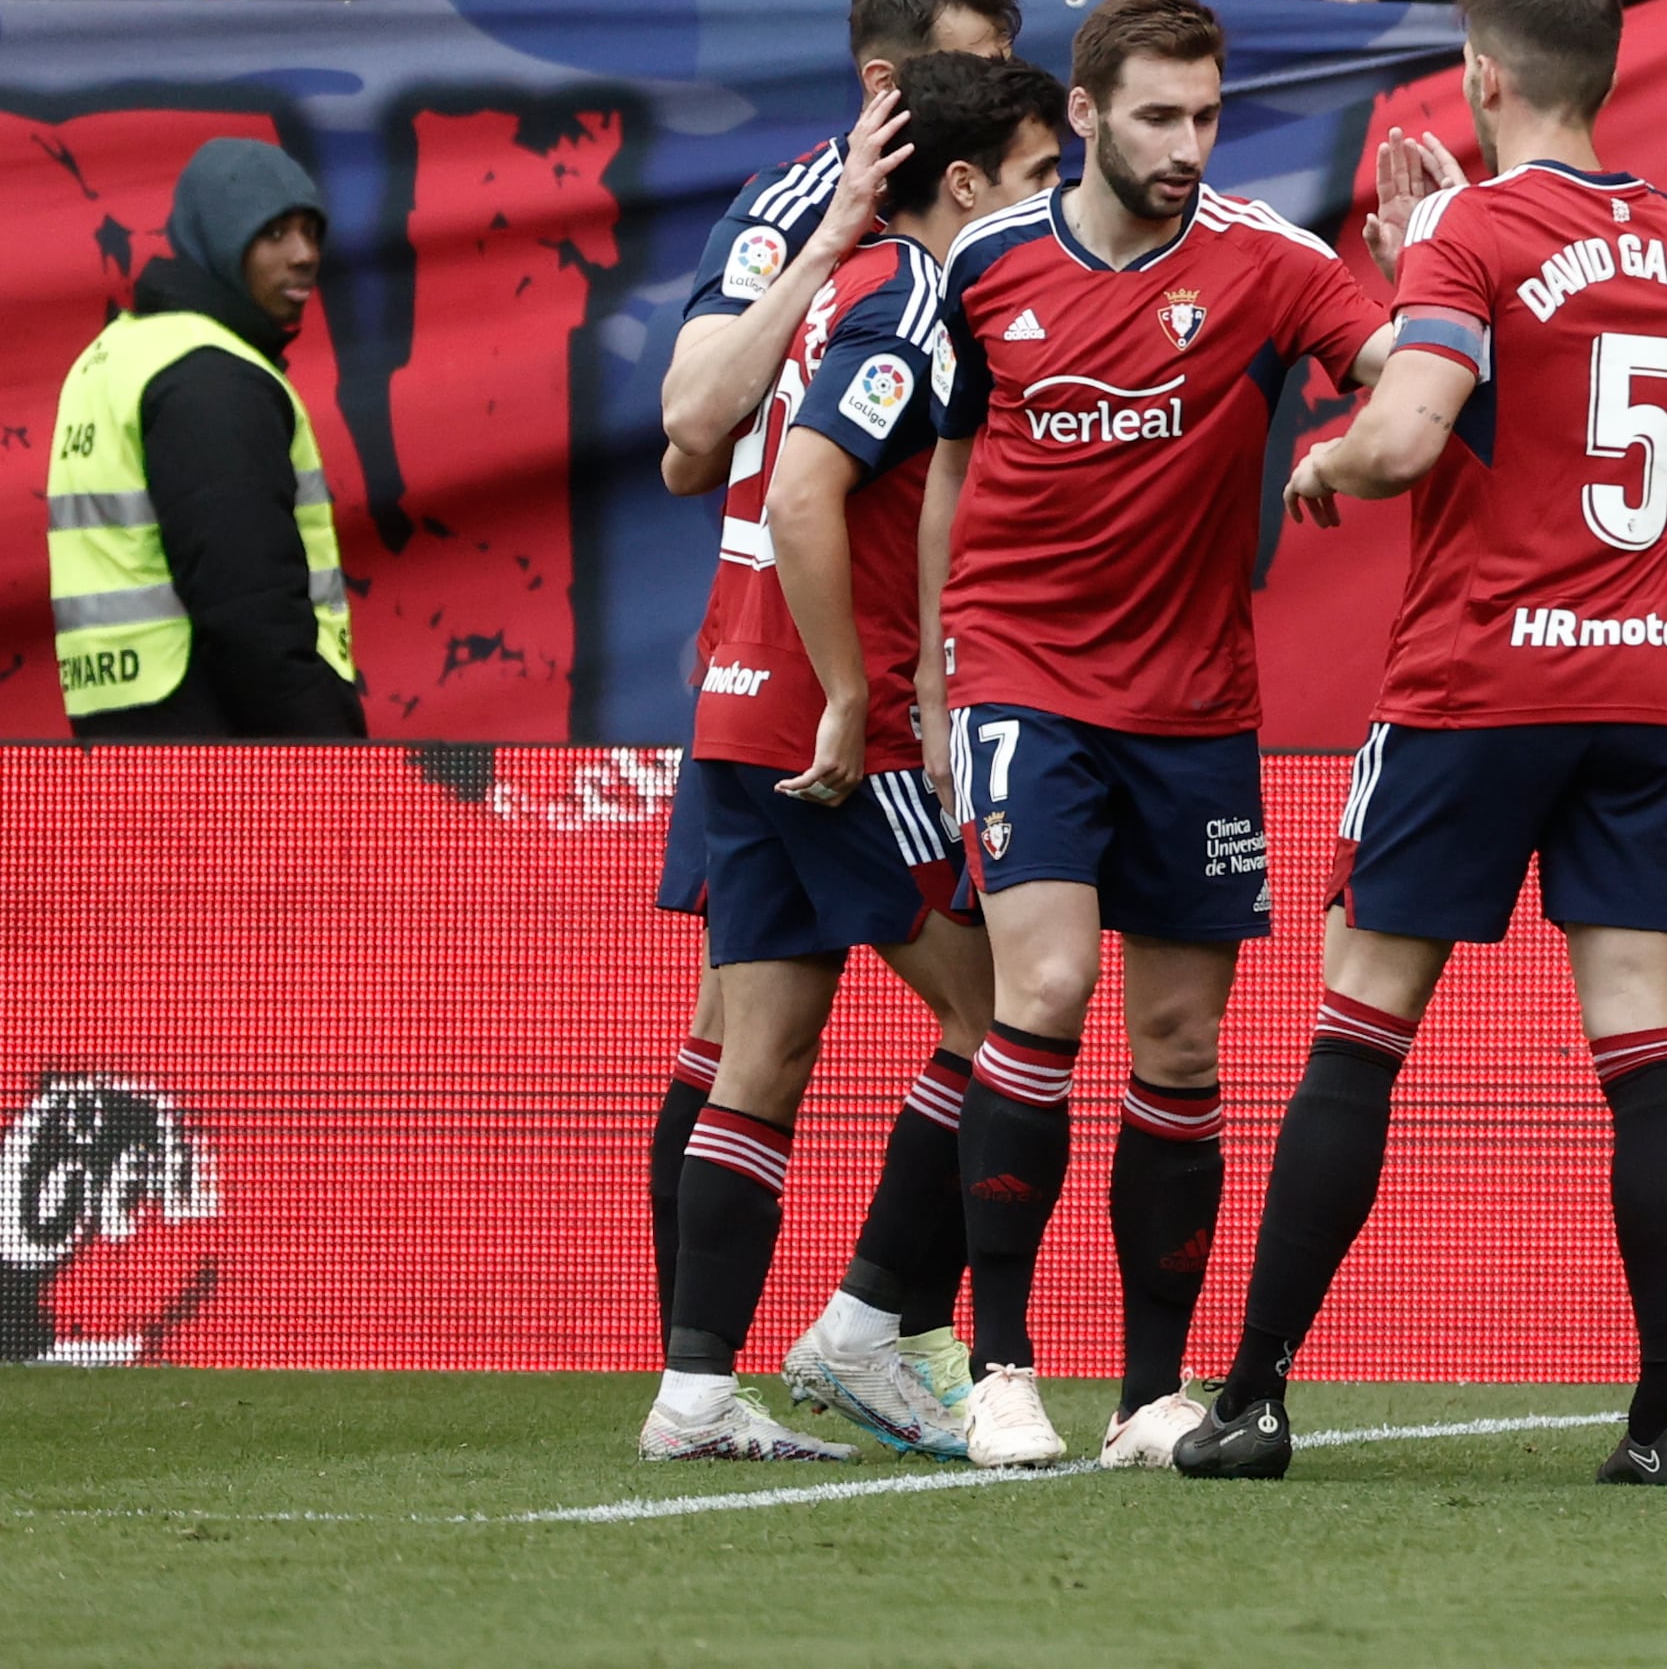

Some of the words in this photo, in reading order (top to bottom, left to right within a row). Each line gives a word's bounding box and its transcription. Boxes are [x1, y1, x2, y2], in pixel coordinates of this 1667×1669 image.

[1516, 236, 1617, 323] DAVID
[1004, 328, 1046, 342] adidas
[848, 395, 888, 428] LaLiga
[1023, 398, 1184, 443] verleal
[60, 421, 96, 460] 248
[60, 648, 140, 694] EWARD
[977, 719, 1021, 803] 7
[1206, 817, 1252, 839] Clínica
[1205, 858, 1226, 877] de
